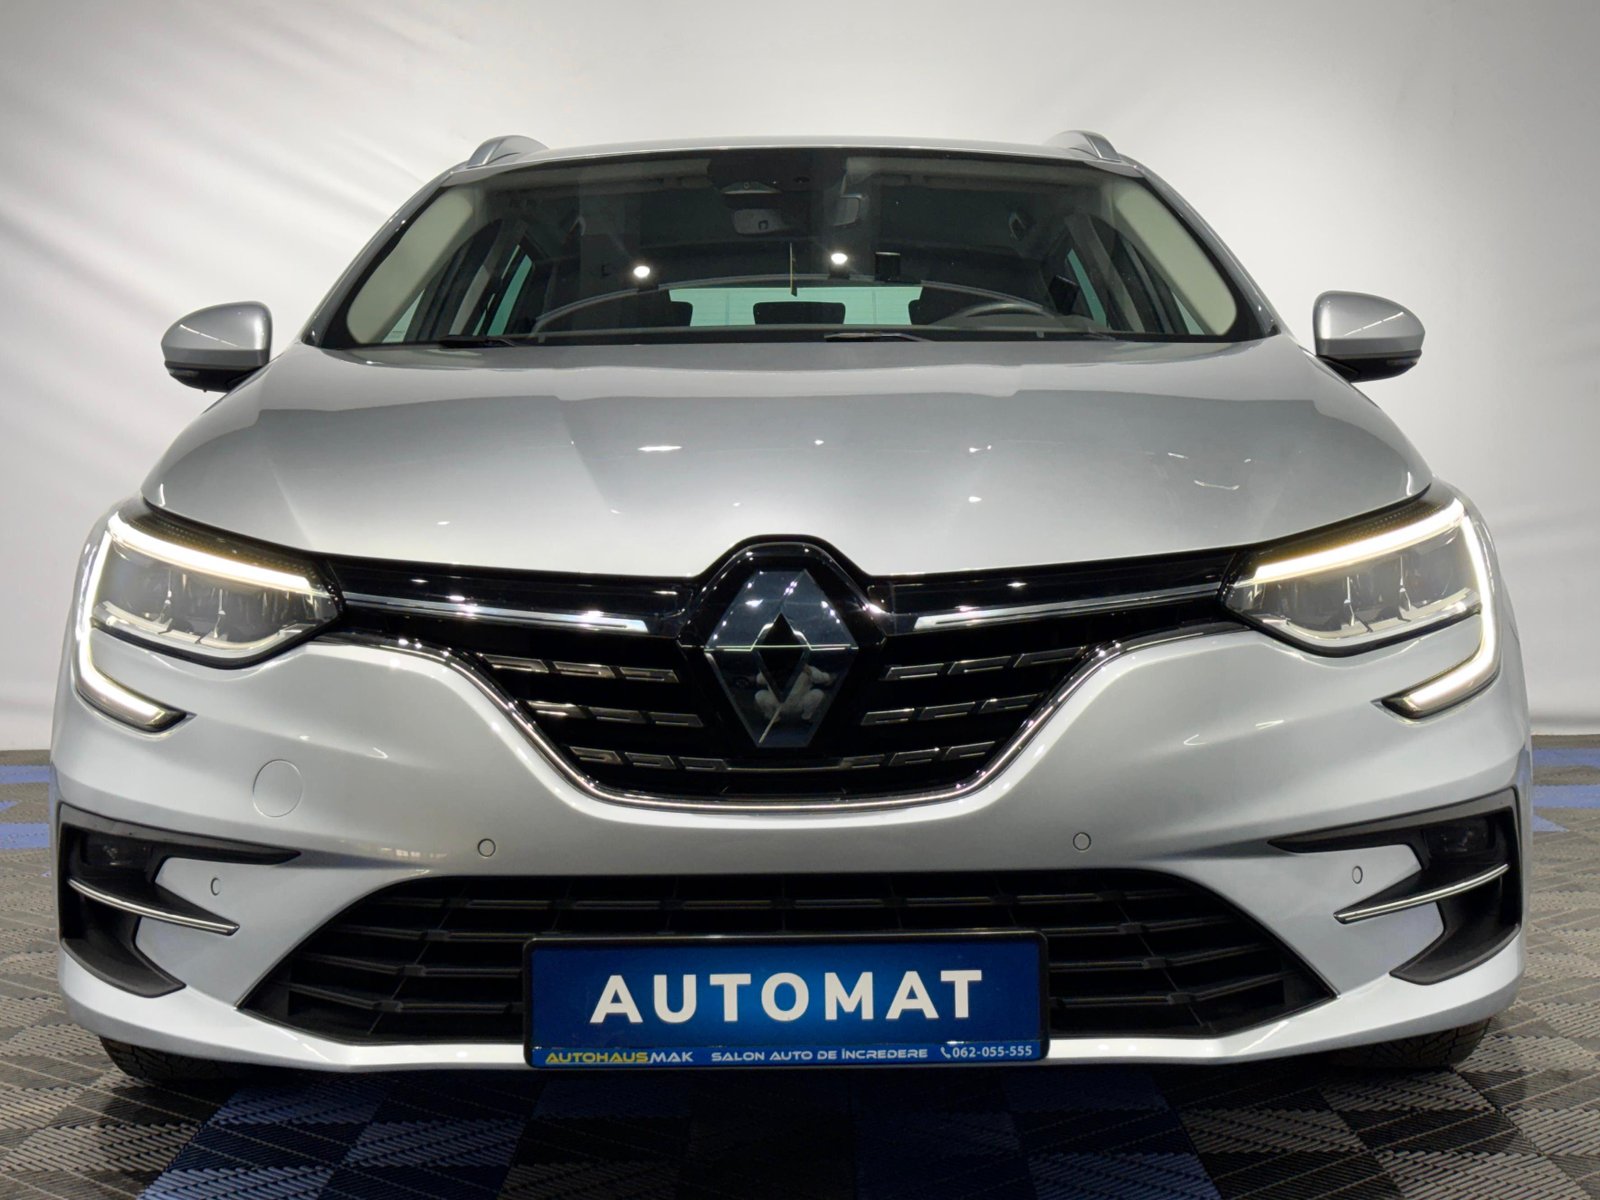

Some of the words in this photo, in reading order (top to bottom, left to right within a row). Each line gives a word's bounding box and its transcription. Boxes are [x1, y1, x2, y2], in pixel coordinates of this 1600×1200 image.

[589, 969, 982, 1023] AUTOMAT
[711, 1051, 765, 1062] SALON
[769, 1050, 813, 1061] AUTO
[817, 1050, 838, 1060] DE
[952, 1045, 1033, 1058] 062-055-555
